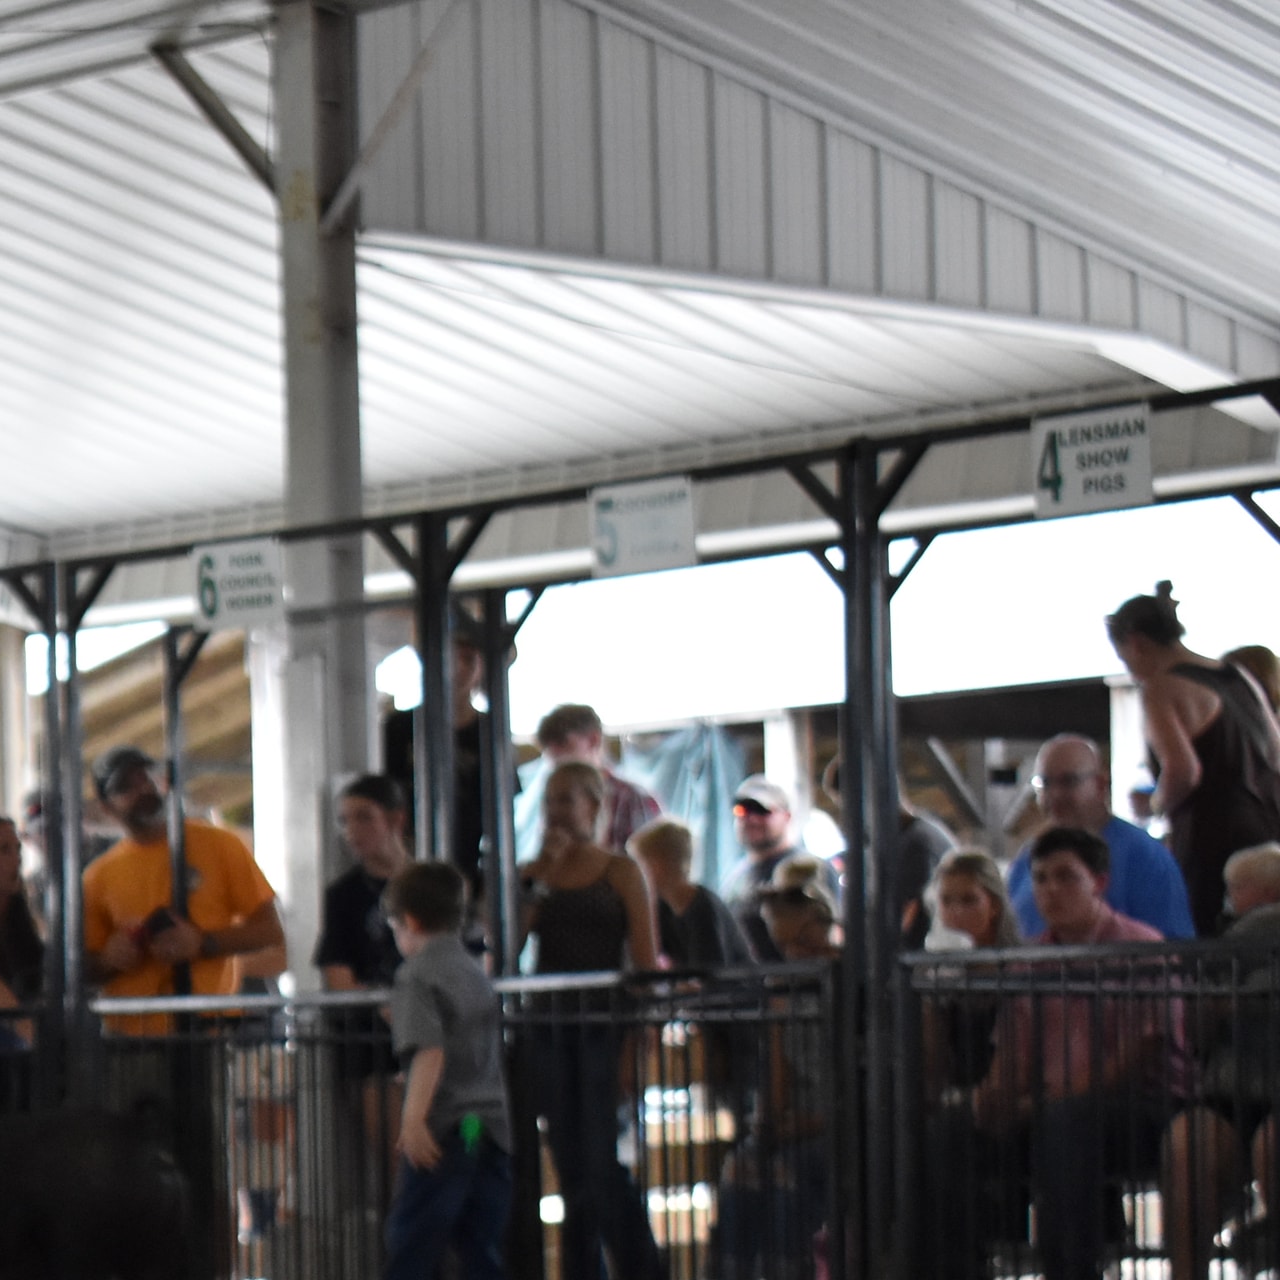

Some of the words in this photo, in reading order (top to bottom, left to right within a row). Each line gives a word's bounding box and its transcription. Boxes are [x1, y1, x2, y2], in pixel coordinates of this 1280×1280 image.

[1058, 419, 1146, 446] LENSMAN
[1037, 430, 1062, 502] 4
[1076, 446, 1130, 471] SHOW
[1083, 474, 1126, 495] PIGS
[596, 498, 618, 567] 5
[197, 555, 217, 618] 6
[225, 593, 274, 610] WOMEN
